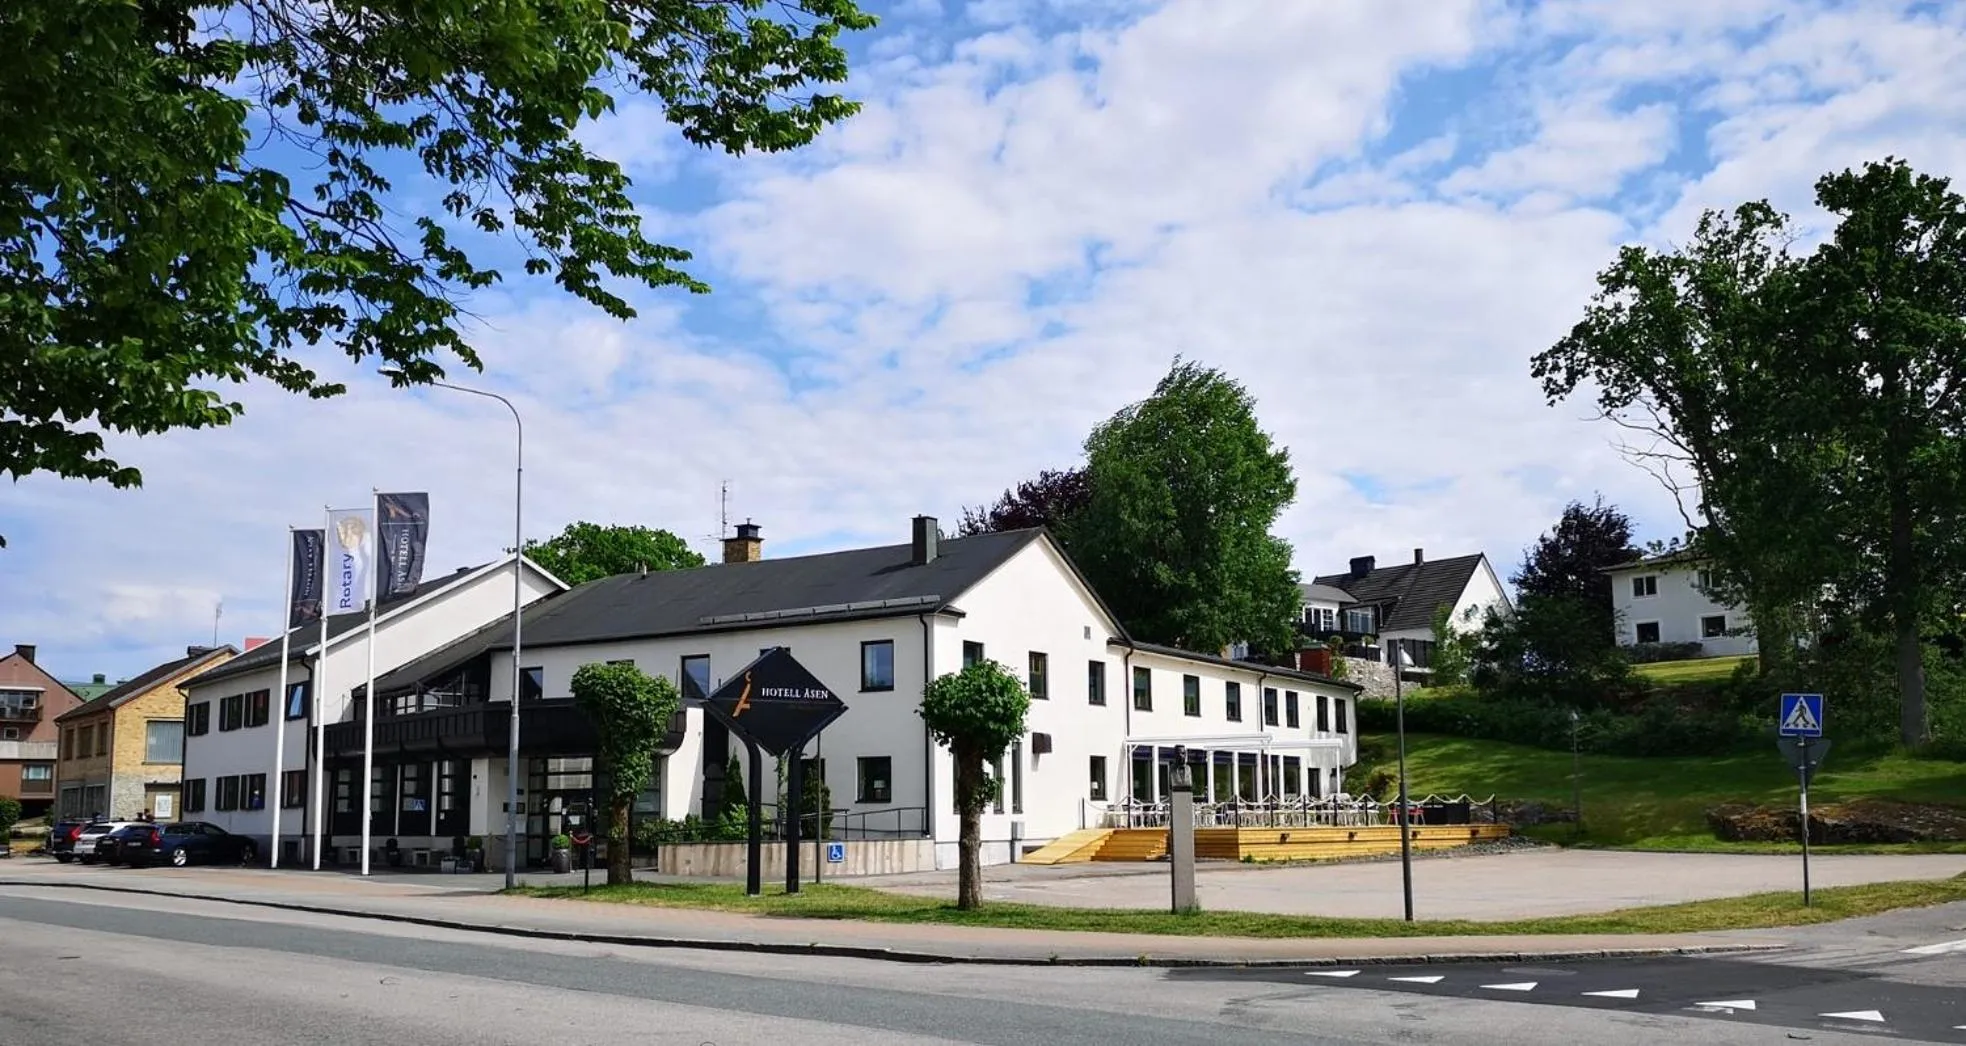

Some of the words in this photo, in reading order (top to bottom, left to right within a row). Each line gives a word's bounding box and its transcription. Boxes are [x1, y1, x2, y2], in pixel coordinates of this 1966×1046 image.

[399, 529, 409, 568] HOTELL
[340, 553, 354, 609] Rotary
[761, 687, 801, 698] HOTELL
[803, 687, 829, 700] ÅSEN
